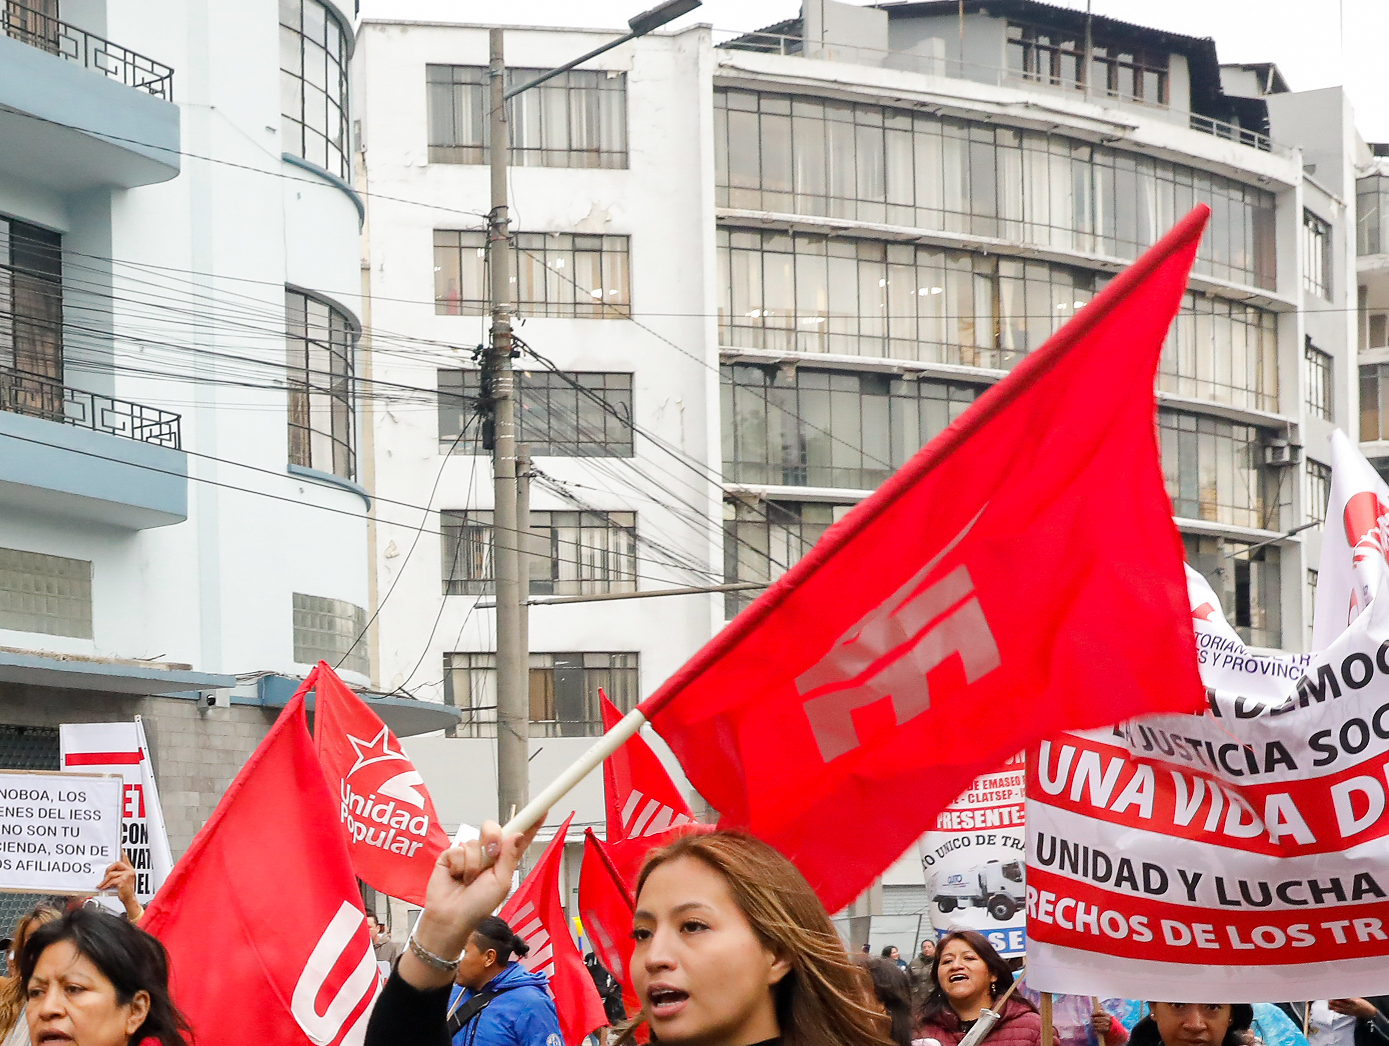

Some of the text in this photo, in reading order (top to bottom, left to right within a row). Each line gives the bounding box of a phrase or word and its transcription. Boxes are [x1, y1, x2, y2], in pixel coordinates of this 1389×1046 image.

[1212, 652, 1221, 667] Y
[1138, 723, 1299, 777] JUSTICIA
[1308, 702, 1389, 767] SOC
[983, 776, 1021, 790] EMASEO
[58, 791, 87, 803] LOS
[968, 790, 1012, 804] CLATSEP
[1037, 738, 1389, 846] UNA VIDA D
[38, 808, 65, 820] DEL
[69, 809, 101, 821] IESS
[341, 778, 429, 837] Unidad
[1, 824, 80, 837] NO SON TU
[341, 801, 424, 857] Popular
[55, 844, 85, 856] SON
[90, 845, 109, 857] DE
[935, 836, 970, 859] UNICO
[975, 834, 997, 846] DE
[15, 859, 96, 874] AFILIADOS.
[1036, 832, 1387, 909] UNIDAD Y LUCHA
[1026, 884, 1389, 950] RECHOS DE LOS TR
